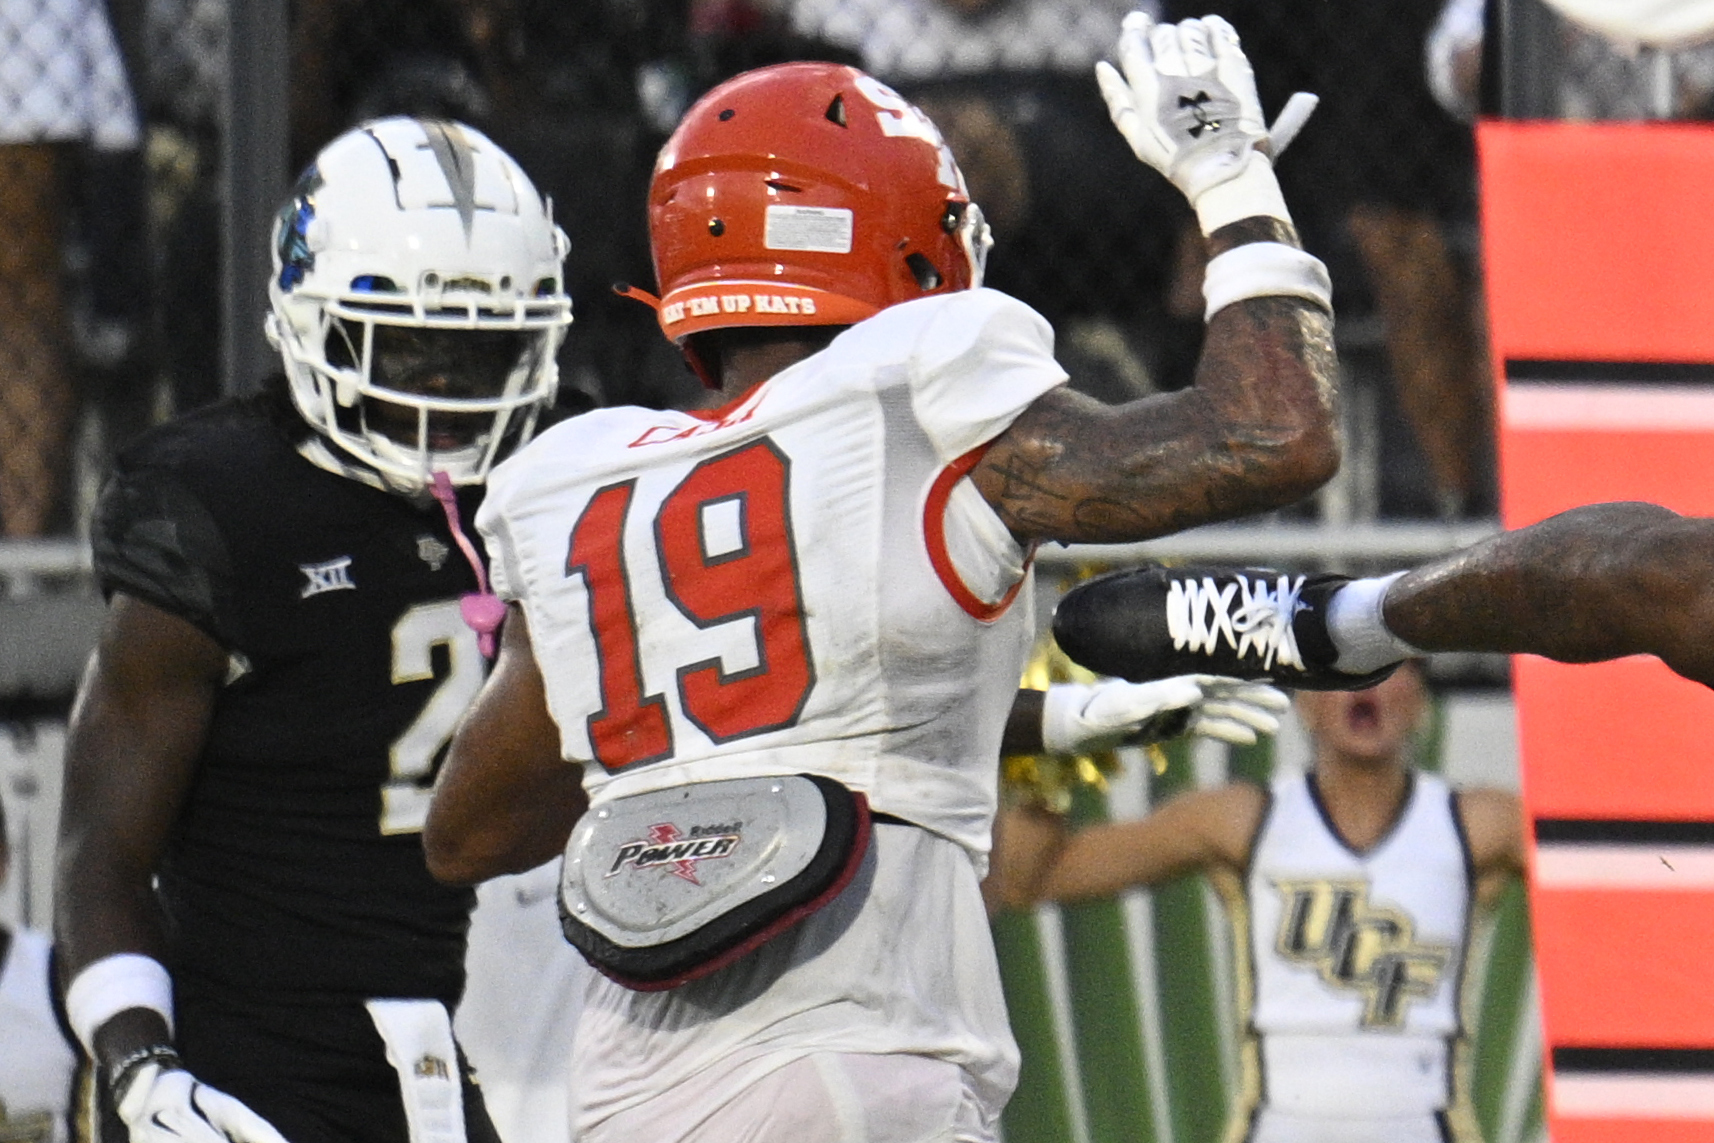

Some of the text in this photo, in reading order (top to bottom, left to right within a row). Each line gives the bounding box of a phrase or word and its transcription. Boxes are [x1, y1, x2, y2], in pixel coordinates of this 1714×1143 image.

[721, 295, 751, 312] UP
[754, 295, 816, 314] KATS
[565, 435, 818, 776] 19
[379, 600, 488, 837] 2
[1268, 876, 1460, 1032] UCF
